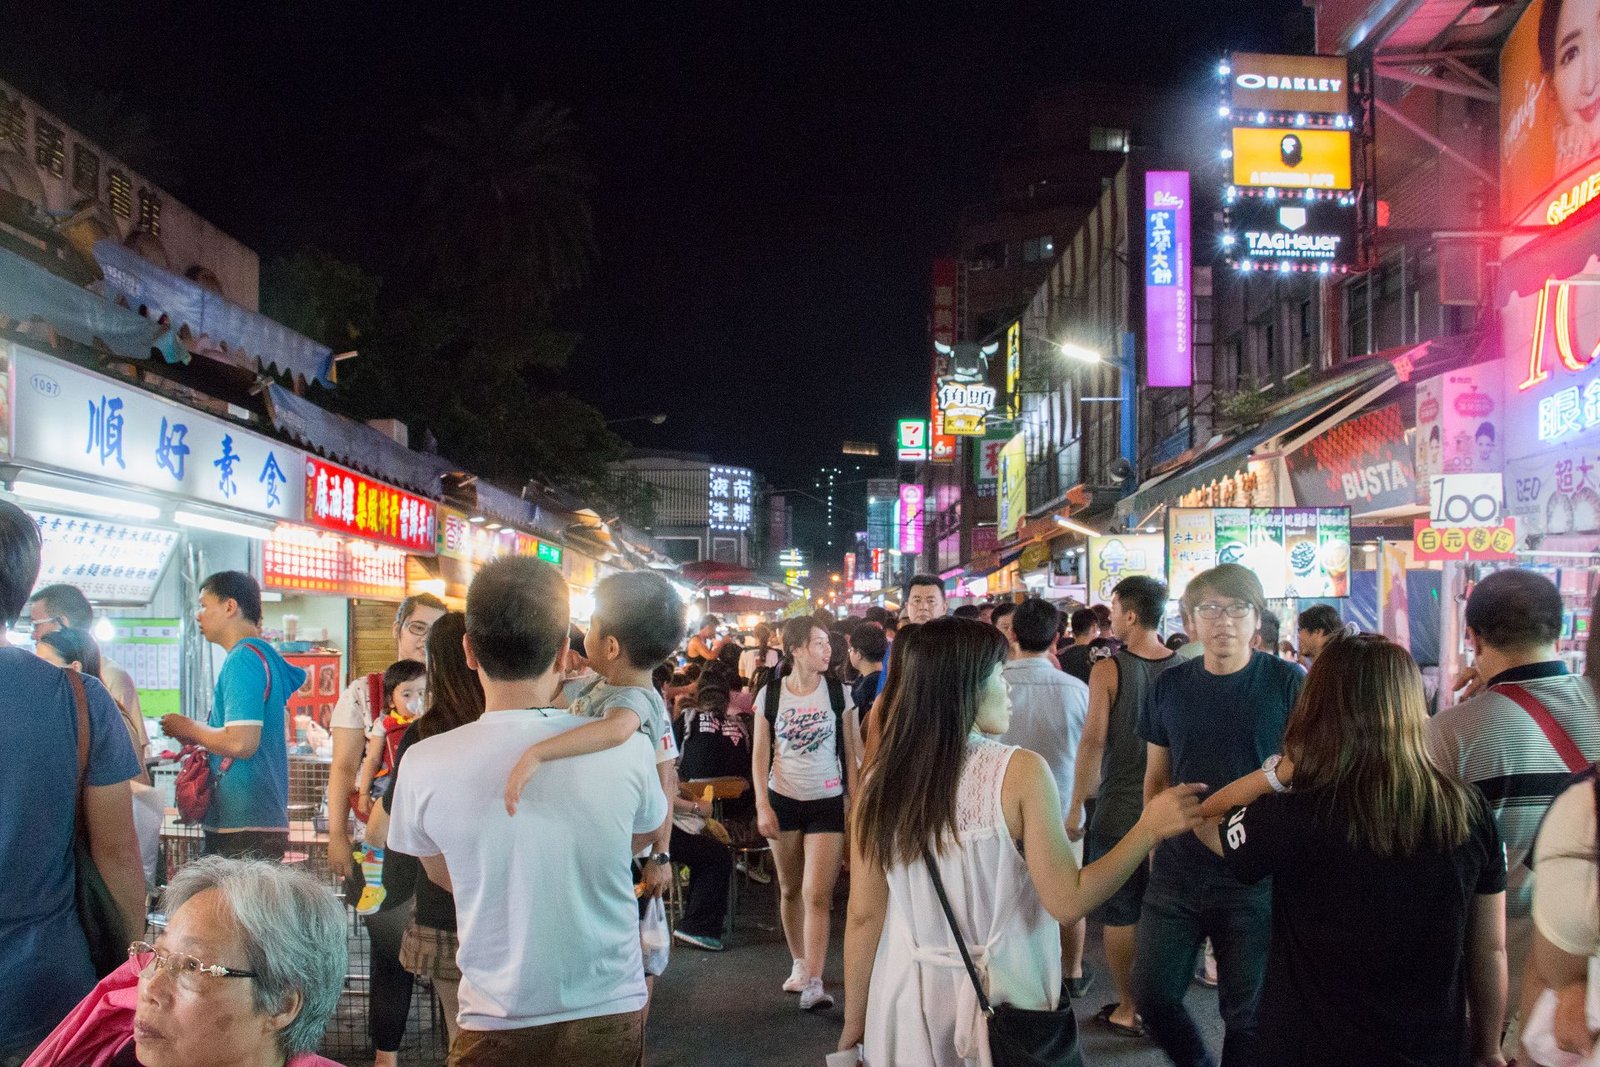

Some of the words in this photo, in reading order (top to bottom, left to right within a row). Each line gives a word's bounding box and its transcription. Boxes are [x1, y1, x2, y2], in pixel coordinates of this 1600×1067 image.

[1266, 76, 1342, 92] OAKLEY
[33, 376, 60, 397] 1097
[87, 395, 287, 510] 順好素食
[1341, 460, 1409, 501] BUSTA
[1554, 455, 1600, 495] 超大
[1432, 477, 1497, 524] 100
